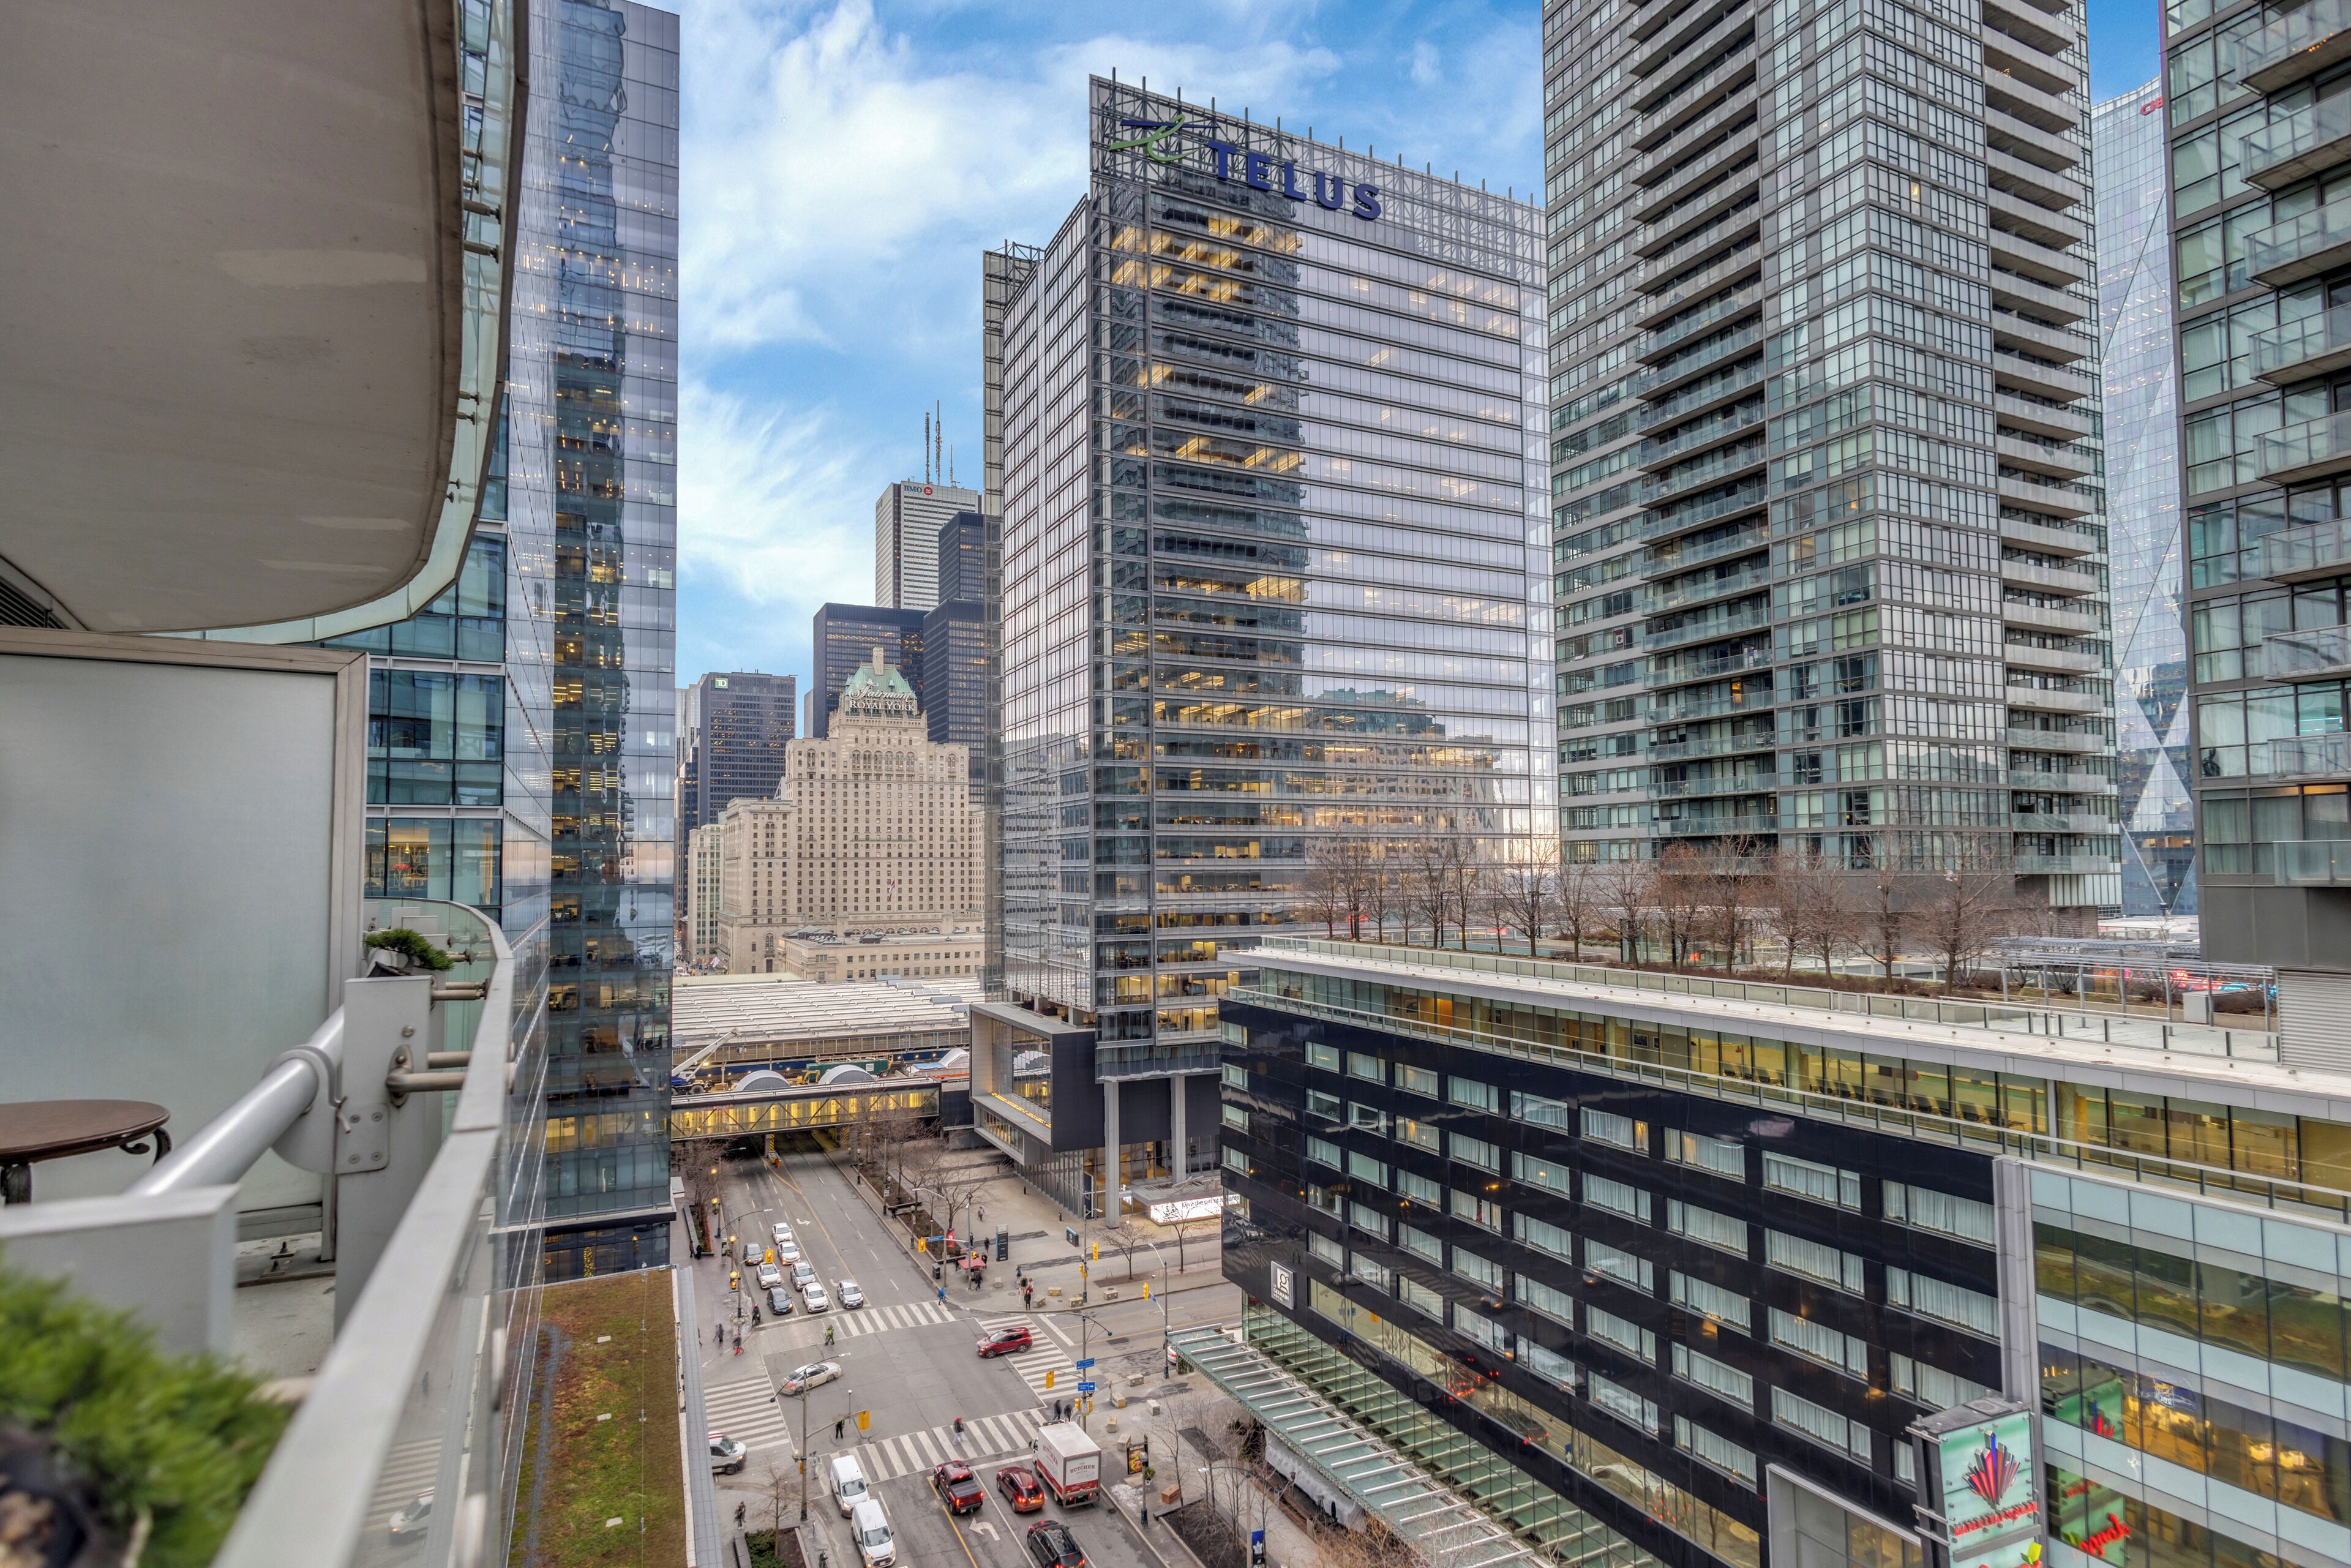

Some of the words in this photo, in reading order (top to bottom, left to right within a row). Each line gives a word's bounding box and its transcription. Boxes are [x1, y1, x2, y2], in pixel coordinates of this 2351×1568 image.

[2140, 94, 2164, 116] CIB
[1208, 140, 1382, 220] TELUS
[849, 681, 915, 702] Fairmont
[850, 700, 882, 710] ROYAL
[886, 701, 914, 711] YORK
[1273, 1288, 1289, 1301] GERMAIN
[1070, 1465, 1095, 1473] BUTCHER
[1954, 1518, 1983, 1536] MAPLE
